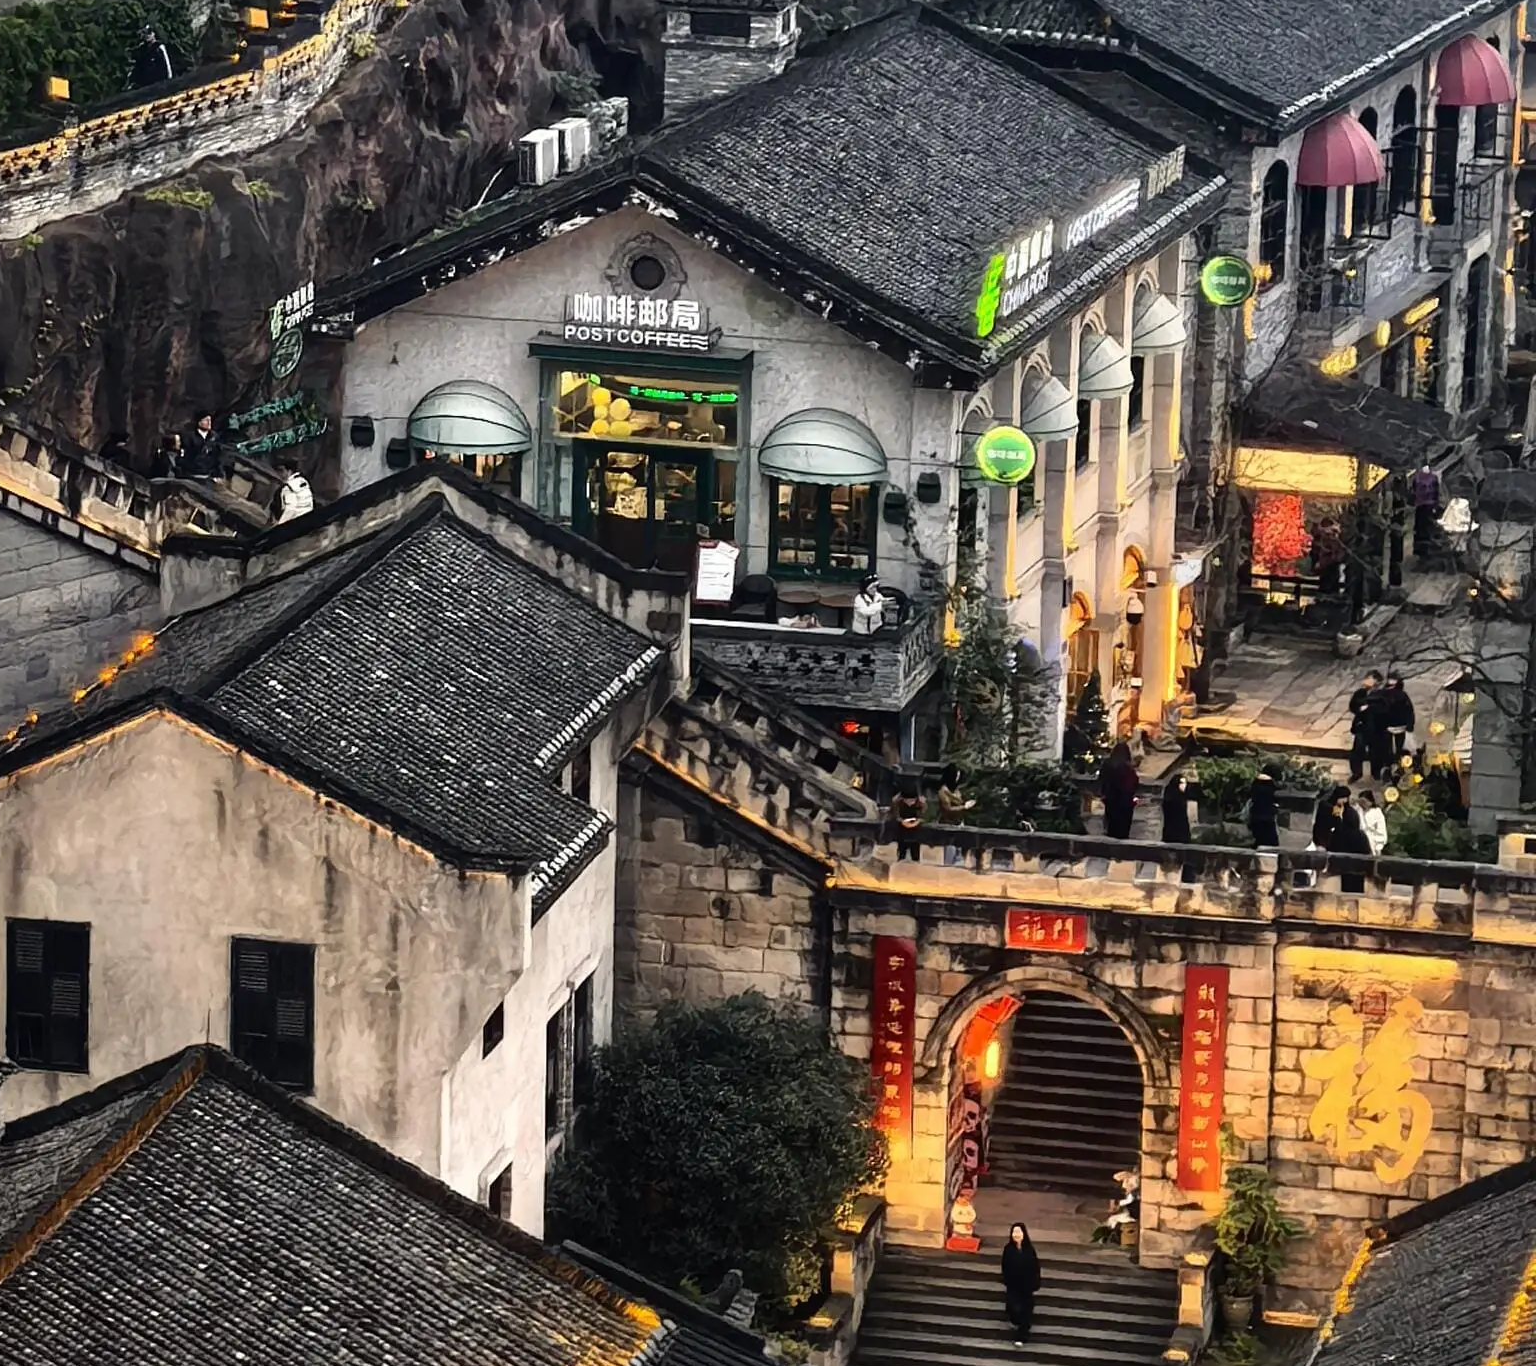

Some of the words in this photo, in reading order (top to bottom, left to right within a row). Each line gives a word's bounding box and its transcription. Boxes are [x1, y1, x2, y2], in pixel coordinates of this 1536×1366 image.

[573, 292, 701, 331] 咖啡邮局
[1299, 995, 1434, 1184] 福
